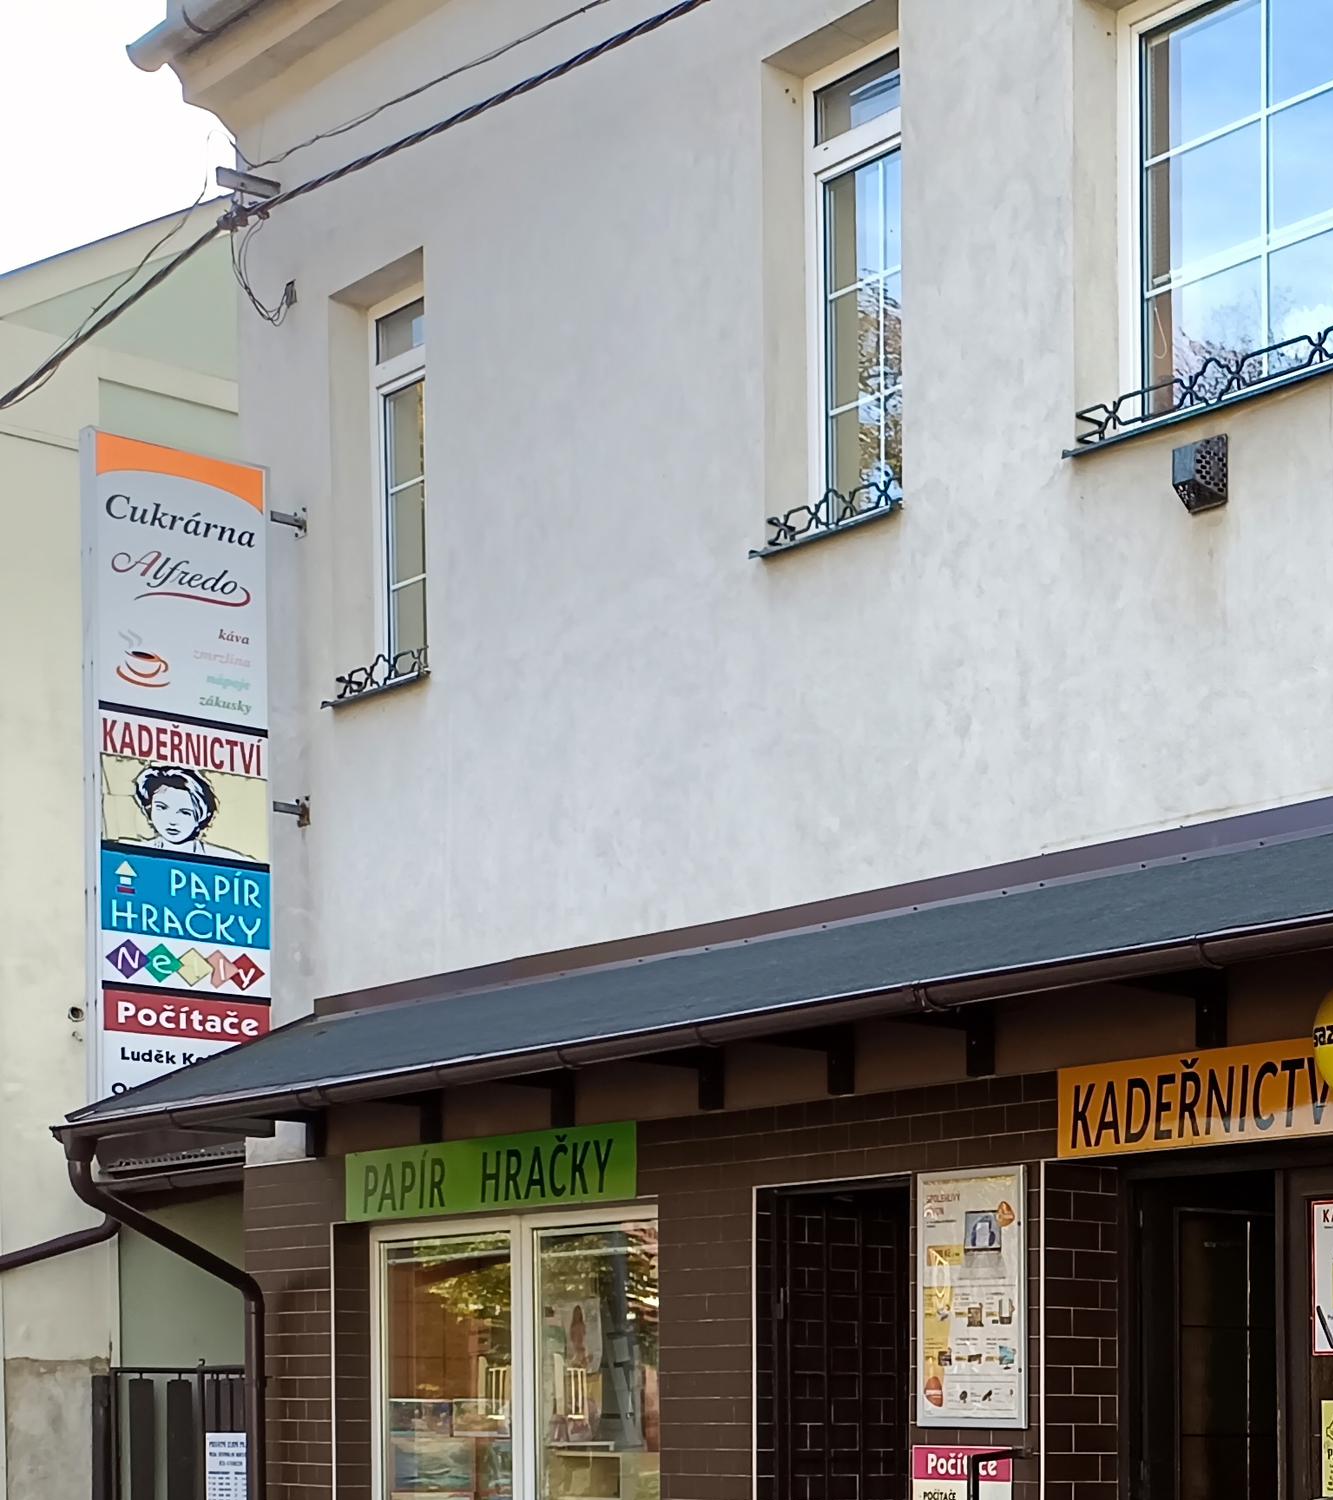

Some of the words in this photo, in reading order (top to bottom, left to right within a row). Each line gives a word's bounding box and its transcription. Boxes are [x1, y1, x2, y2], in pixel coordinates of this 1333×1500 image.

[105, 493, 256, 549] Cukrárna
[111, 550, 251, 603] Alfredo
[218, 628, 250, 645] káva
[199, 695, 252, 715] zákusky
[102, 717, 263, 777] KADEŘNICTVÍ
[169, 868, 262, 909] PAPÍR
[110, 899, 263, 946] HRAČKY
[117, 1000, 260, 1037] Počítače
[120, 1046, 176, 1065] Luděk
[362, 1149, 447, 1214] PAPÍR
[481, 1134, 614, 1204] HRAČKY
